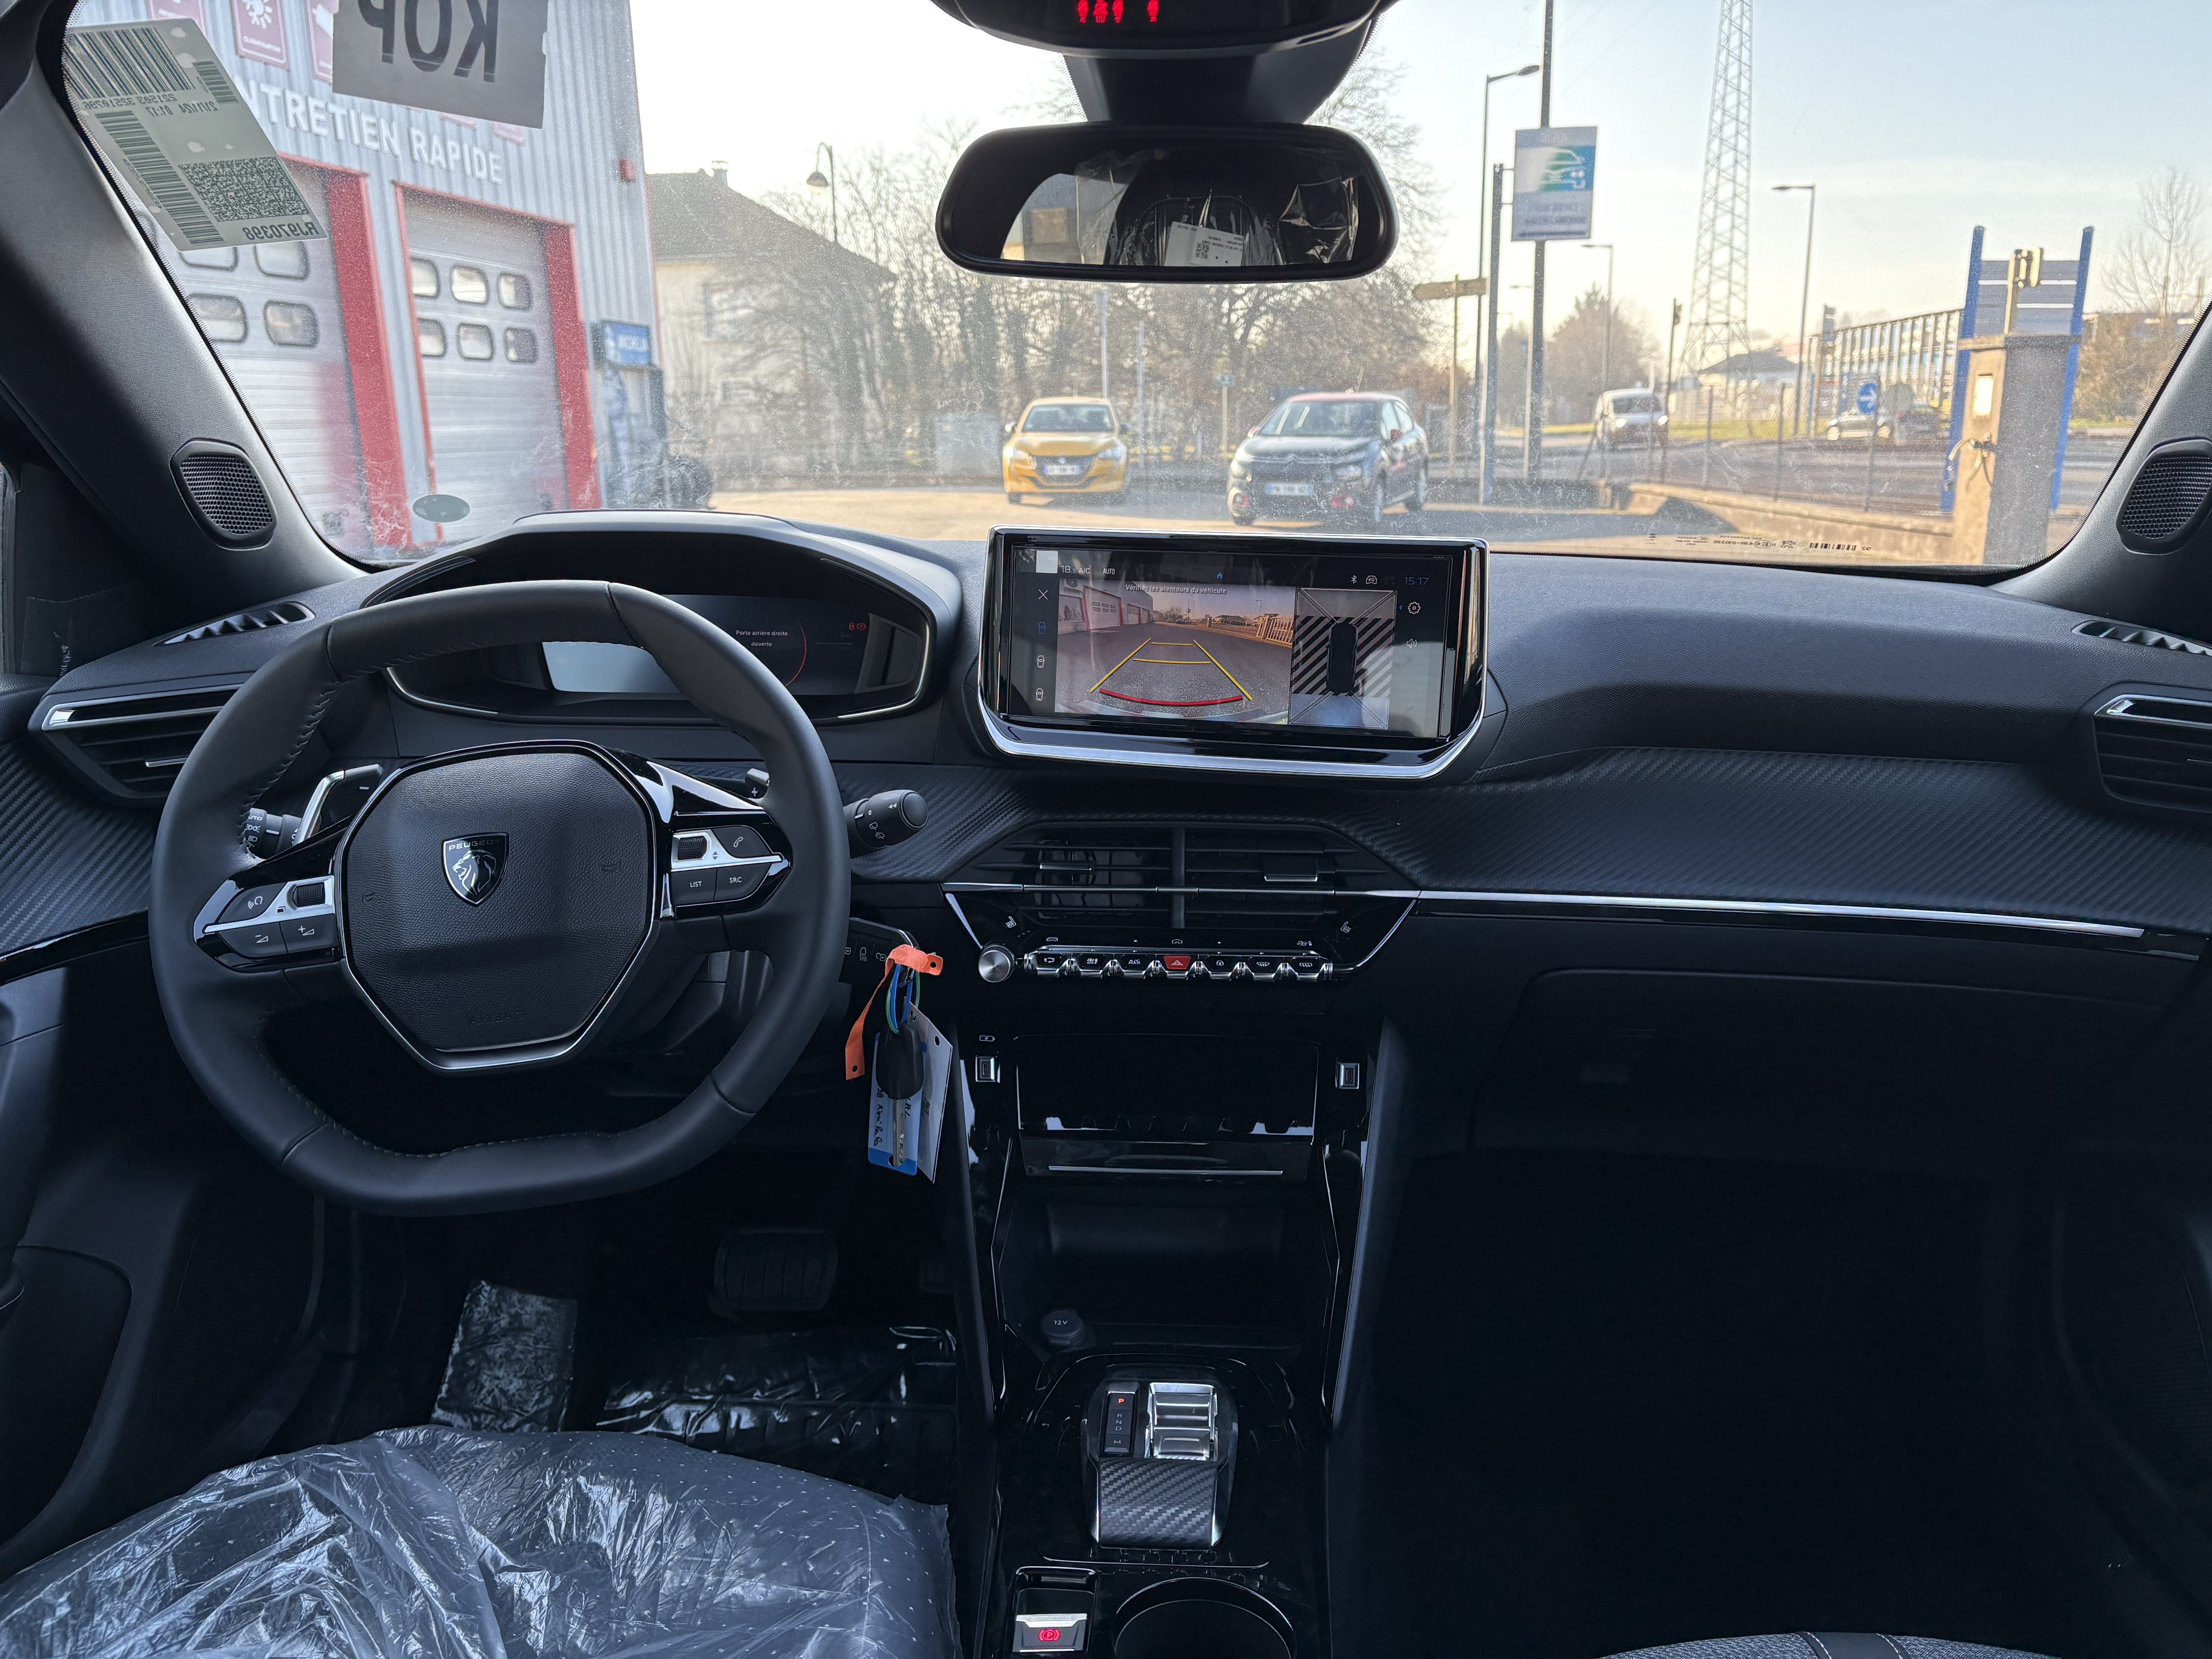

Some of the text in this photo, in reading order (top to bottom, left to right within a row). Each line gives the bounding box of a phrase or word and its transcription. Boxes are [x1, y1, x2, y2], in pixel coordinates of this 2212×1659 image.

[239, 79, 504, 184] NTRETIEN RAPIDE
[1405, 577, 1429, 586] 15:17
[449, 839, 501, 851] PEUGEOT
